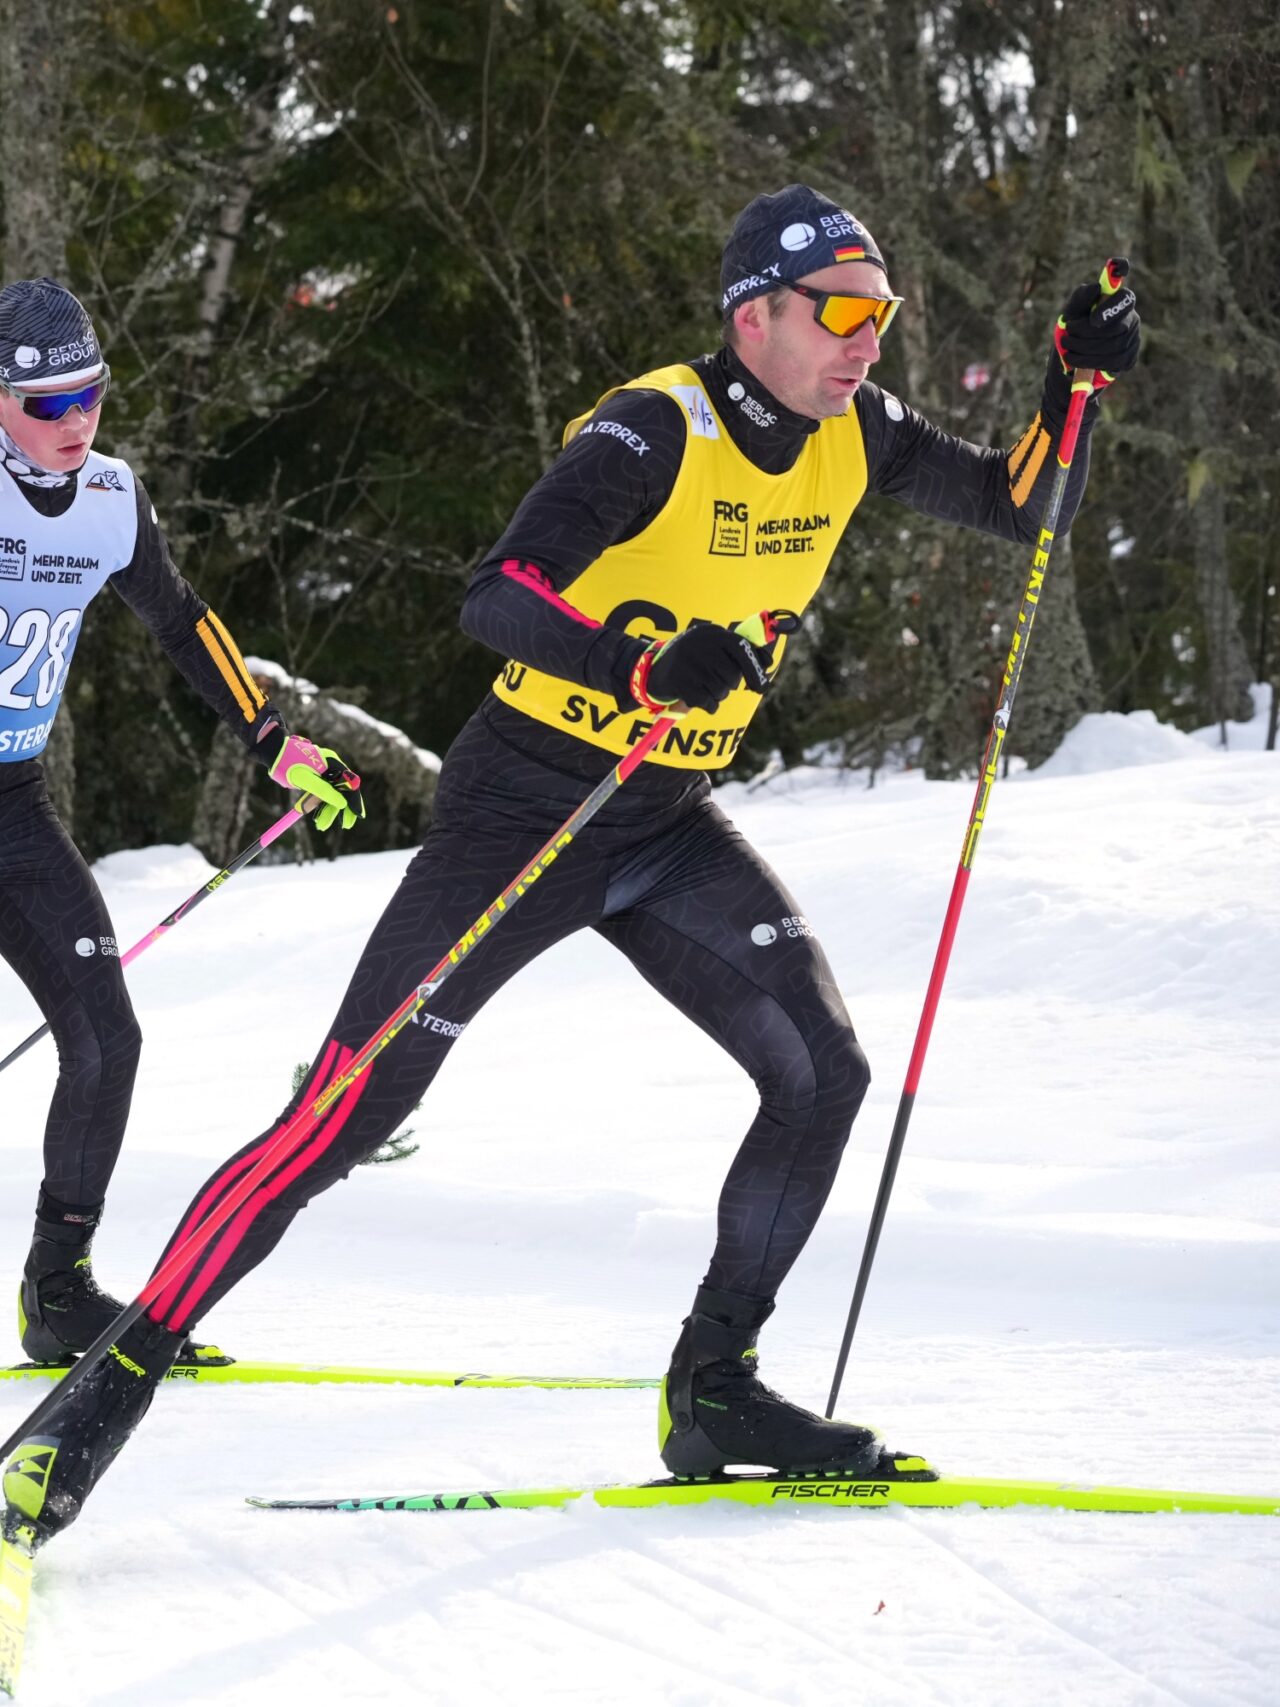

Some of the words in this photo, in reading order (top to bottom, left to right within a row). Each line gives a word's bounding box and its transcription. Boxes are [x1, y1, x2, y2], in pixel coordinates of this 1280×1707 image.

[48, 344, 95, 366] GROUP
[740, 402, 770, 428] GROUP
[745, 395, 777, 424] BERLAC
[594, 421, 651, 456] TERREX
[714, 500, 749, 522] FRG
[756, 518, 790, 535] MEHR
[755, 540, 782, 556] UND
[784, 537, 814, 553] ZEIT.
[32, 555, 65, 568] MEHR
[66, 556, 99, 570] RAUM
[1026, 527, 1055, 605] LEKI
[31, 570, 56, 583] UND
[57, 572, 82, 584] ZEIT.
[560, 695, 619, 733] SV
[293, 742, 324, 770] LEKI
[771, 1484, 890, 1498] FISCHER
